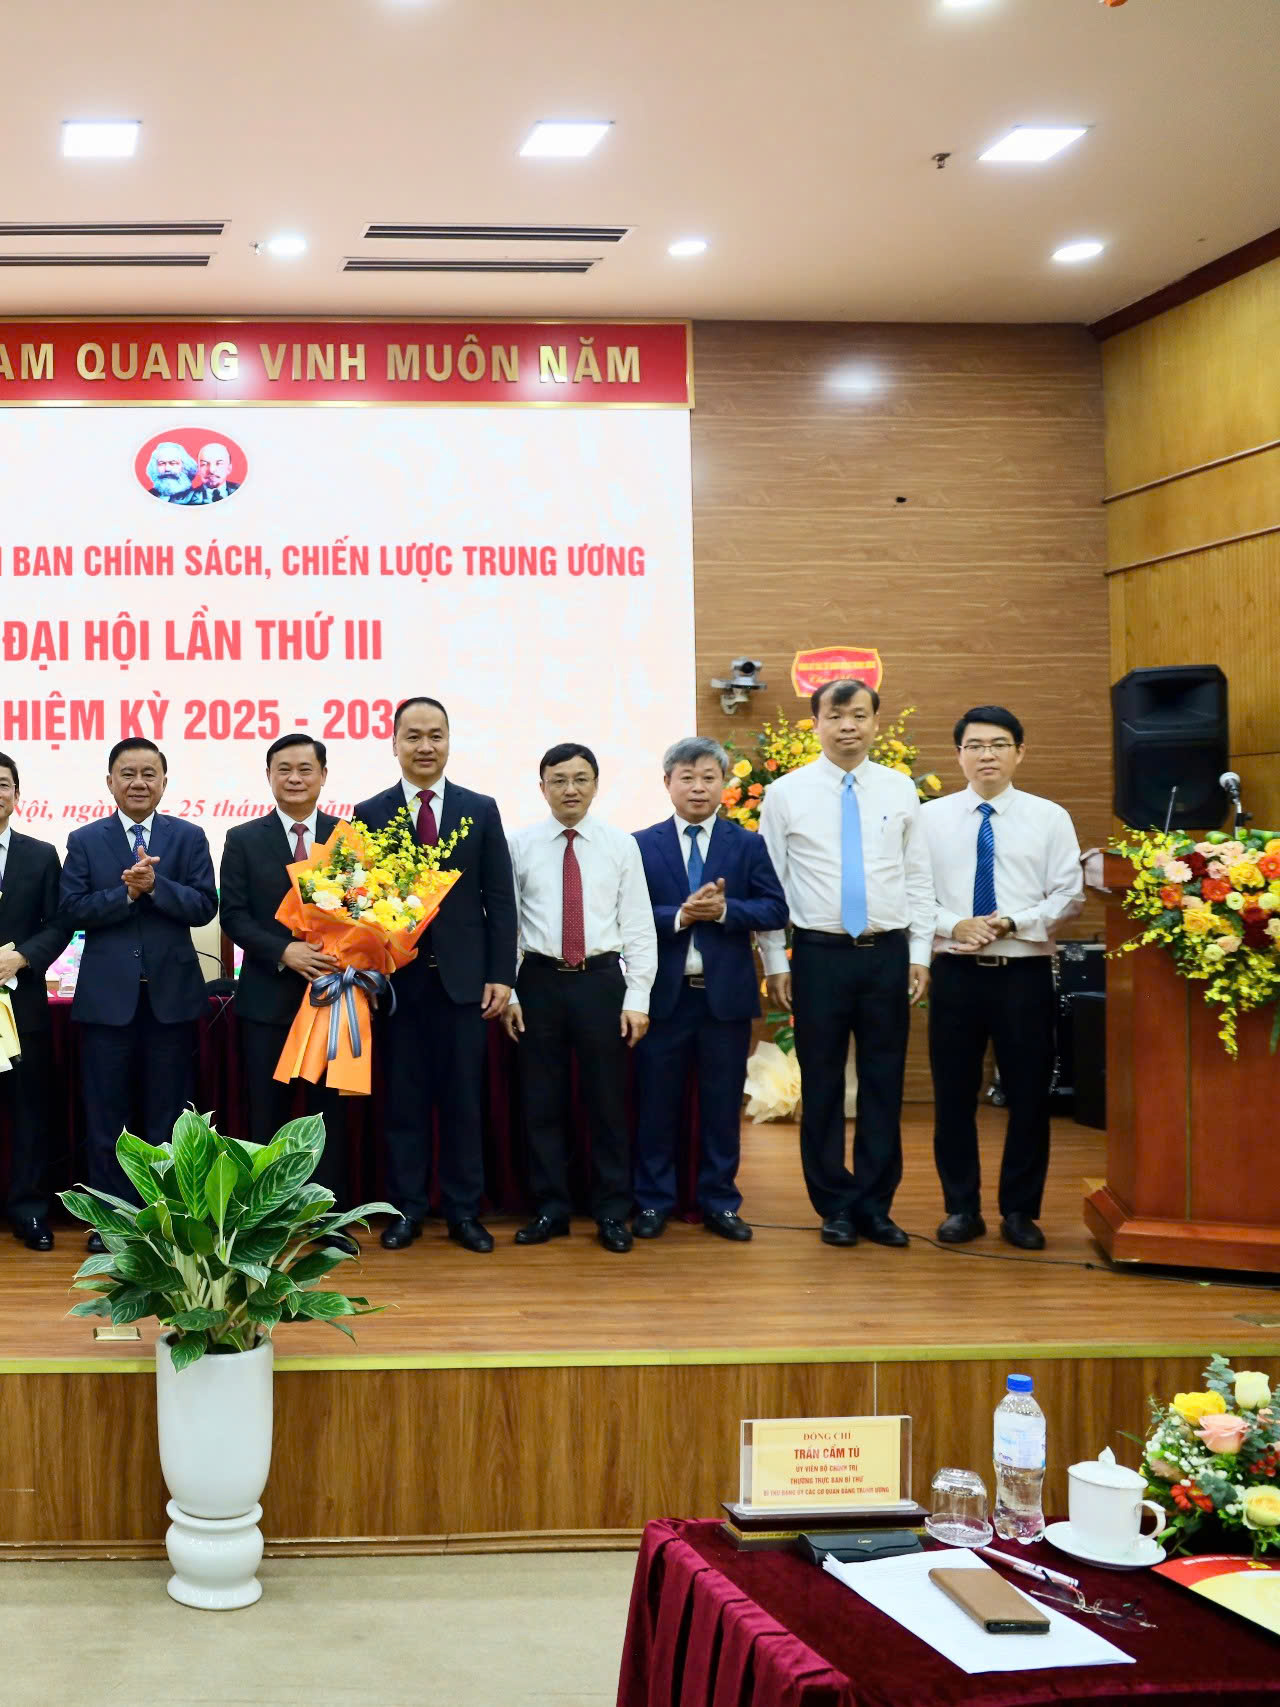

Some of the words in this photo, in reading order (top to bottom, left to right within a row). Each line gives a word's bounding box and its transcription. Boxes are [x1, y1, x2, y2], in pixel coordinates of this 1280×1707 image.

[76, 341, 240, 385] QUANG
[260, 343, 367, 382] VINH
[386, 334, 520, 383] MUÔN
[538, 337, 642, 384] NĂM
[13, 546, 73, 577] BAN
[84, 538, 174, 577] CHÍNH
[184, 538, 272, 579] SÁCH,
[282, 535, 370, 577] CHIẾN
[379, 543, 453, 583] LƯỢC
[462, 545, 558, 577] TRUNG
[567, 543, 645, 577] ƯƠNG
[1, 620, 69, 671] ĐẠI
[85, 611, 150, 671] HỘI
[166, 605, 242, 661] LẦN
[255, 610, 335, 661] THỨ
[344, 619, 382, 661] III
[120, 690, 170, 740] KỲ
[183, 699, 281, 740] 2025
[295, 718, 309, 727] -
[322, 699, 408, 740] 203
[179, 799, 206, 818] 25
